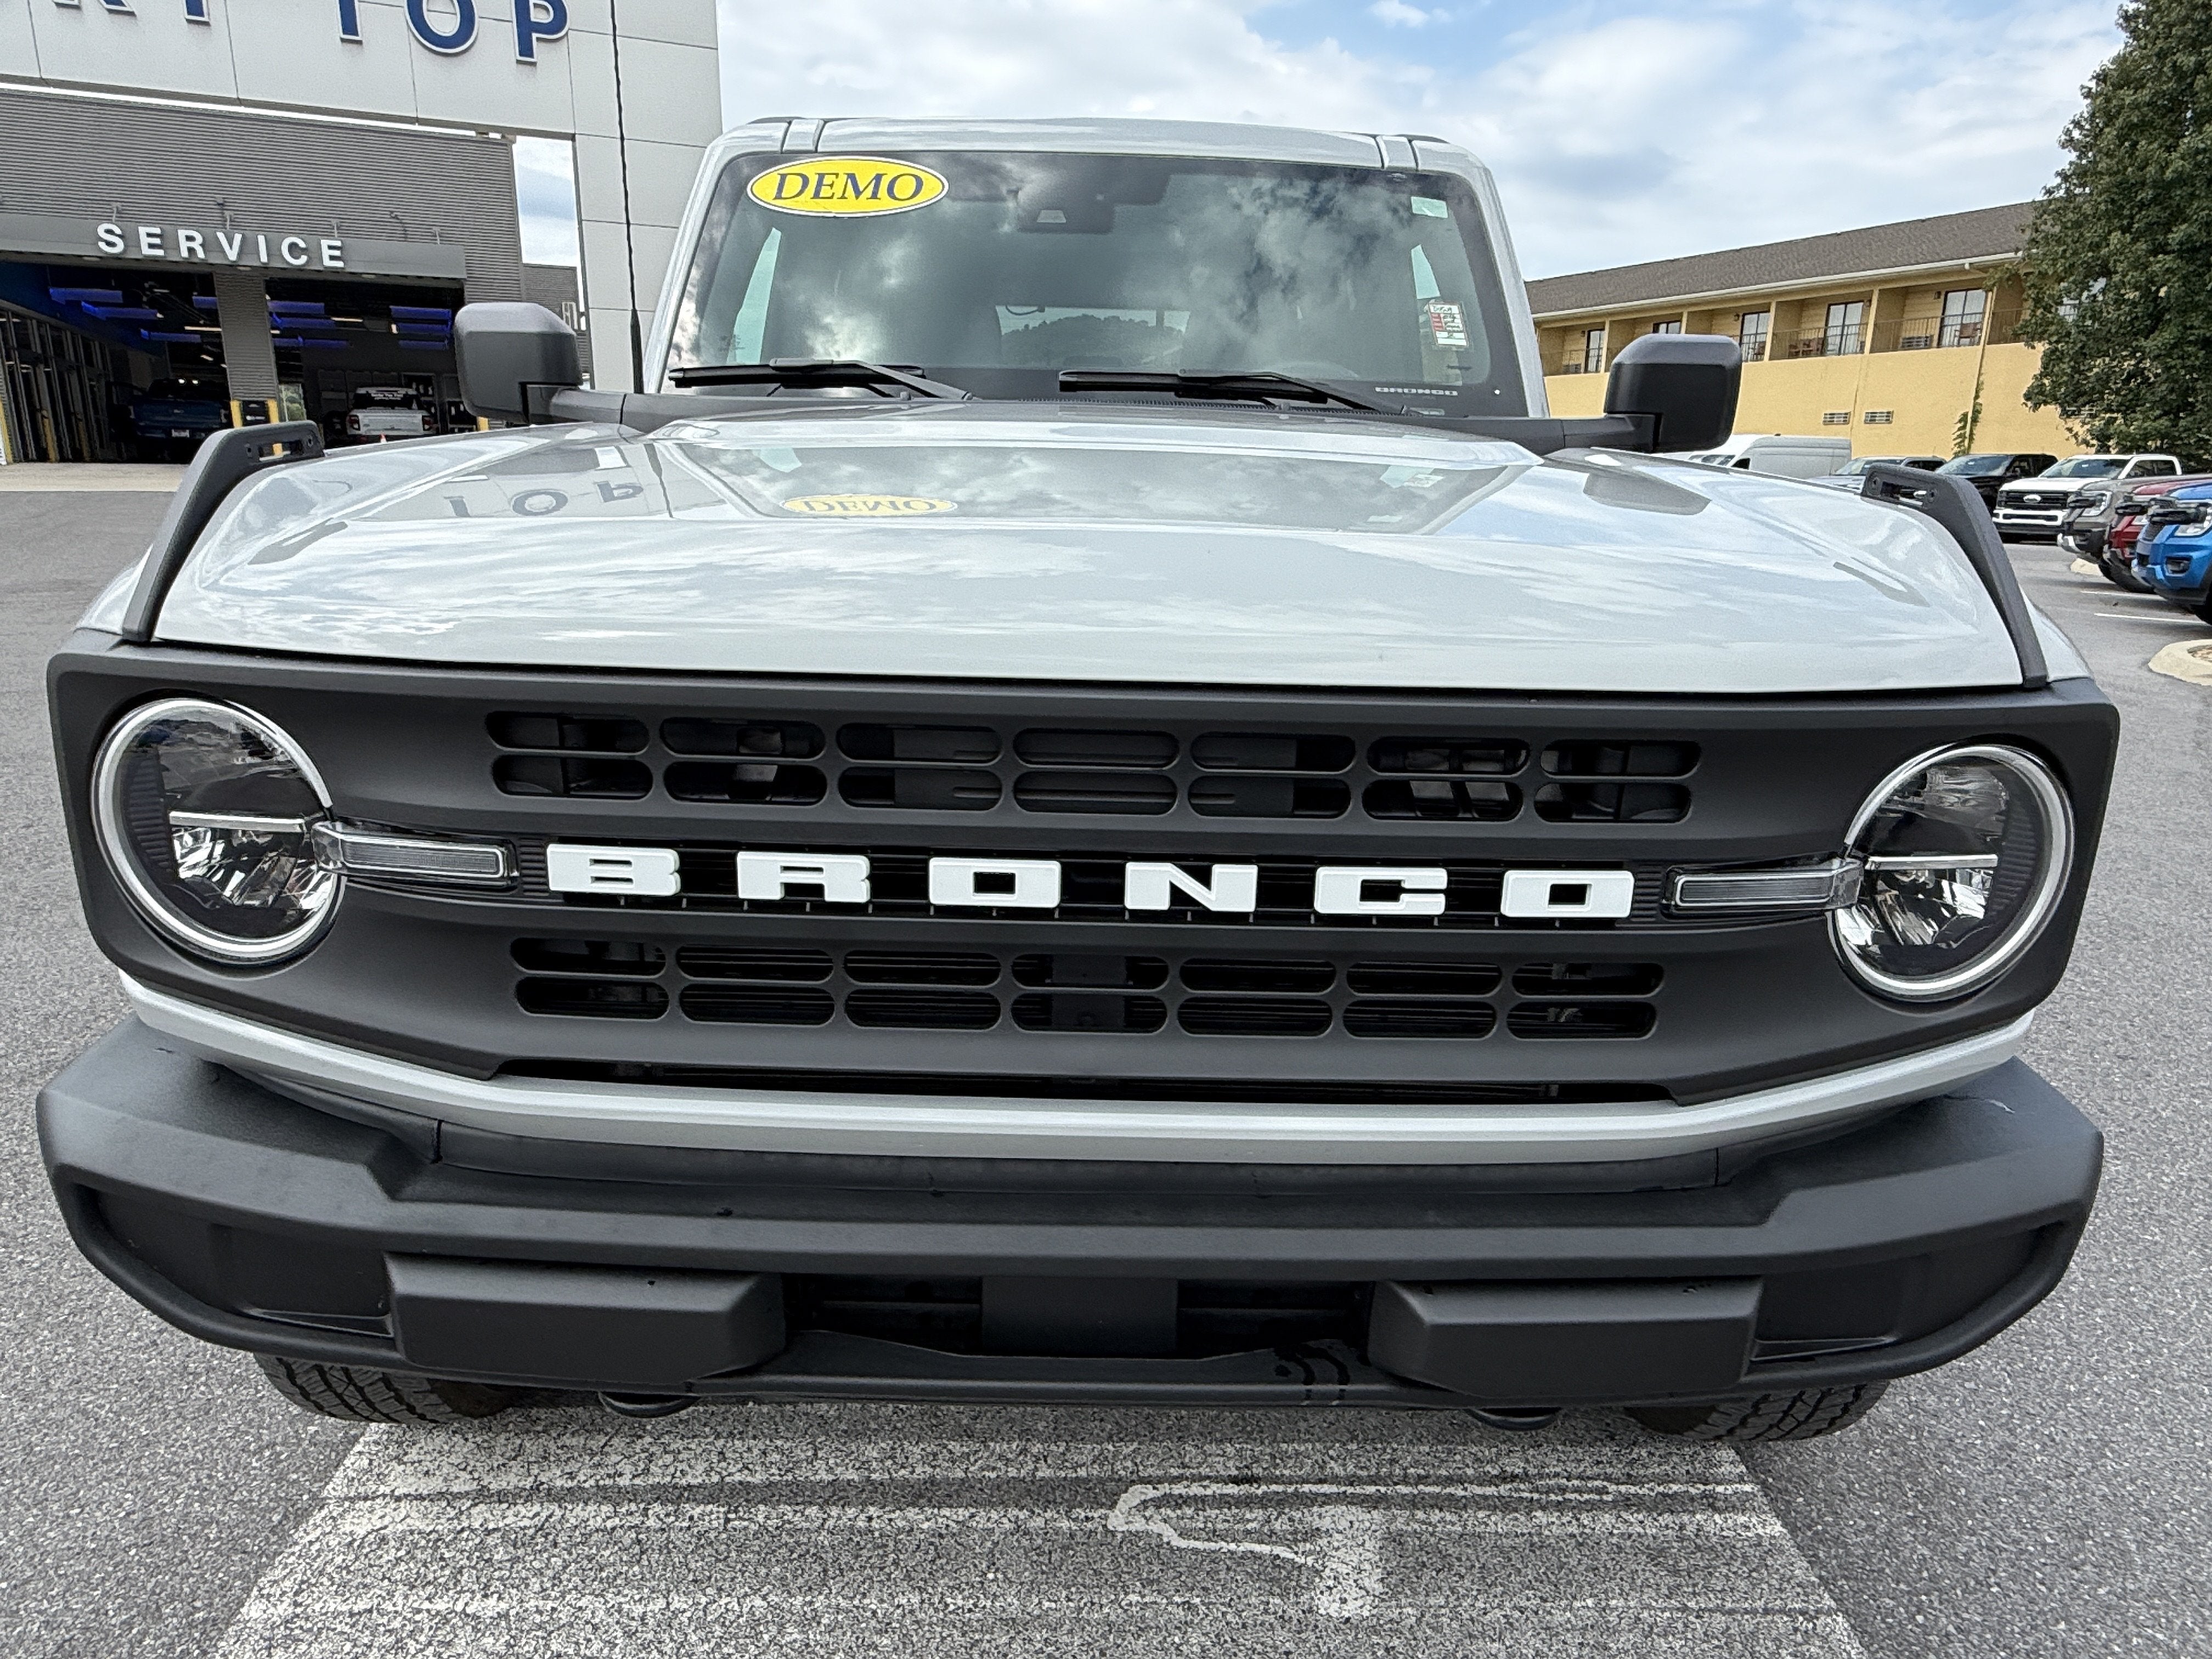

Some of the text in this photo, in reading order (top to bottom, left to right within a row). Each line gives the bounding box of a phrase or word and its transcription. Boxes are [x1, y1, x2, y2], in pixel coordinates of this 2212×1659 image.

[772, 172, 924, 201] DEMO
[96, 222, 345, 268] SERVICE
[547, 844, 1634, 919] BRONCO
